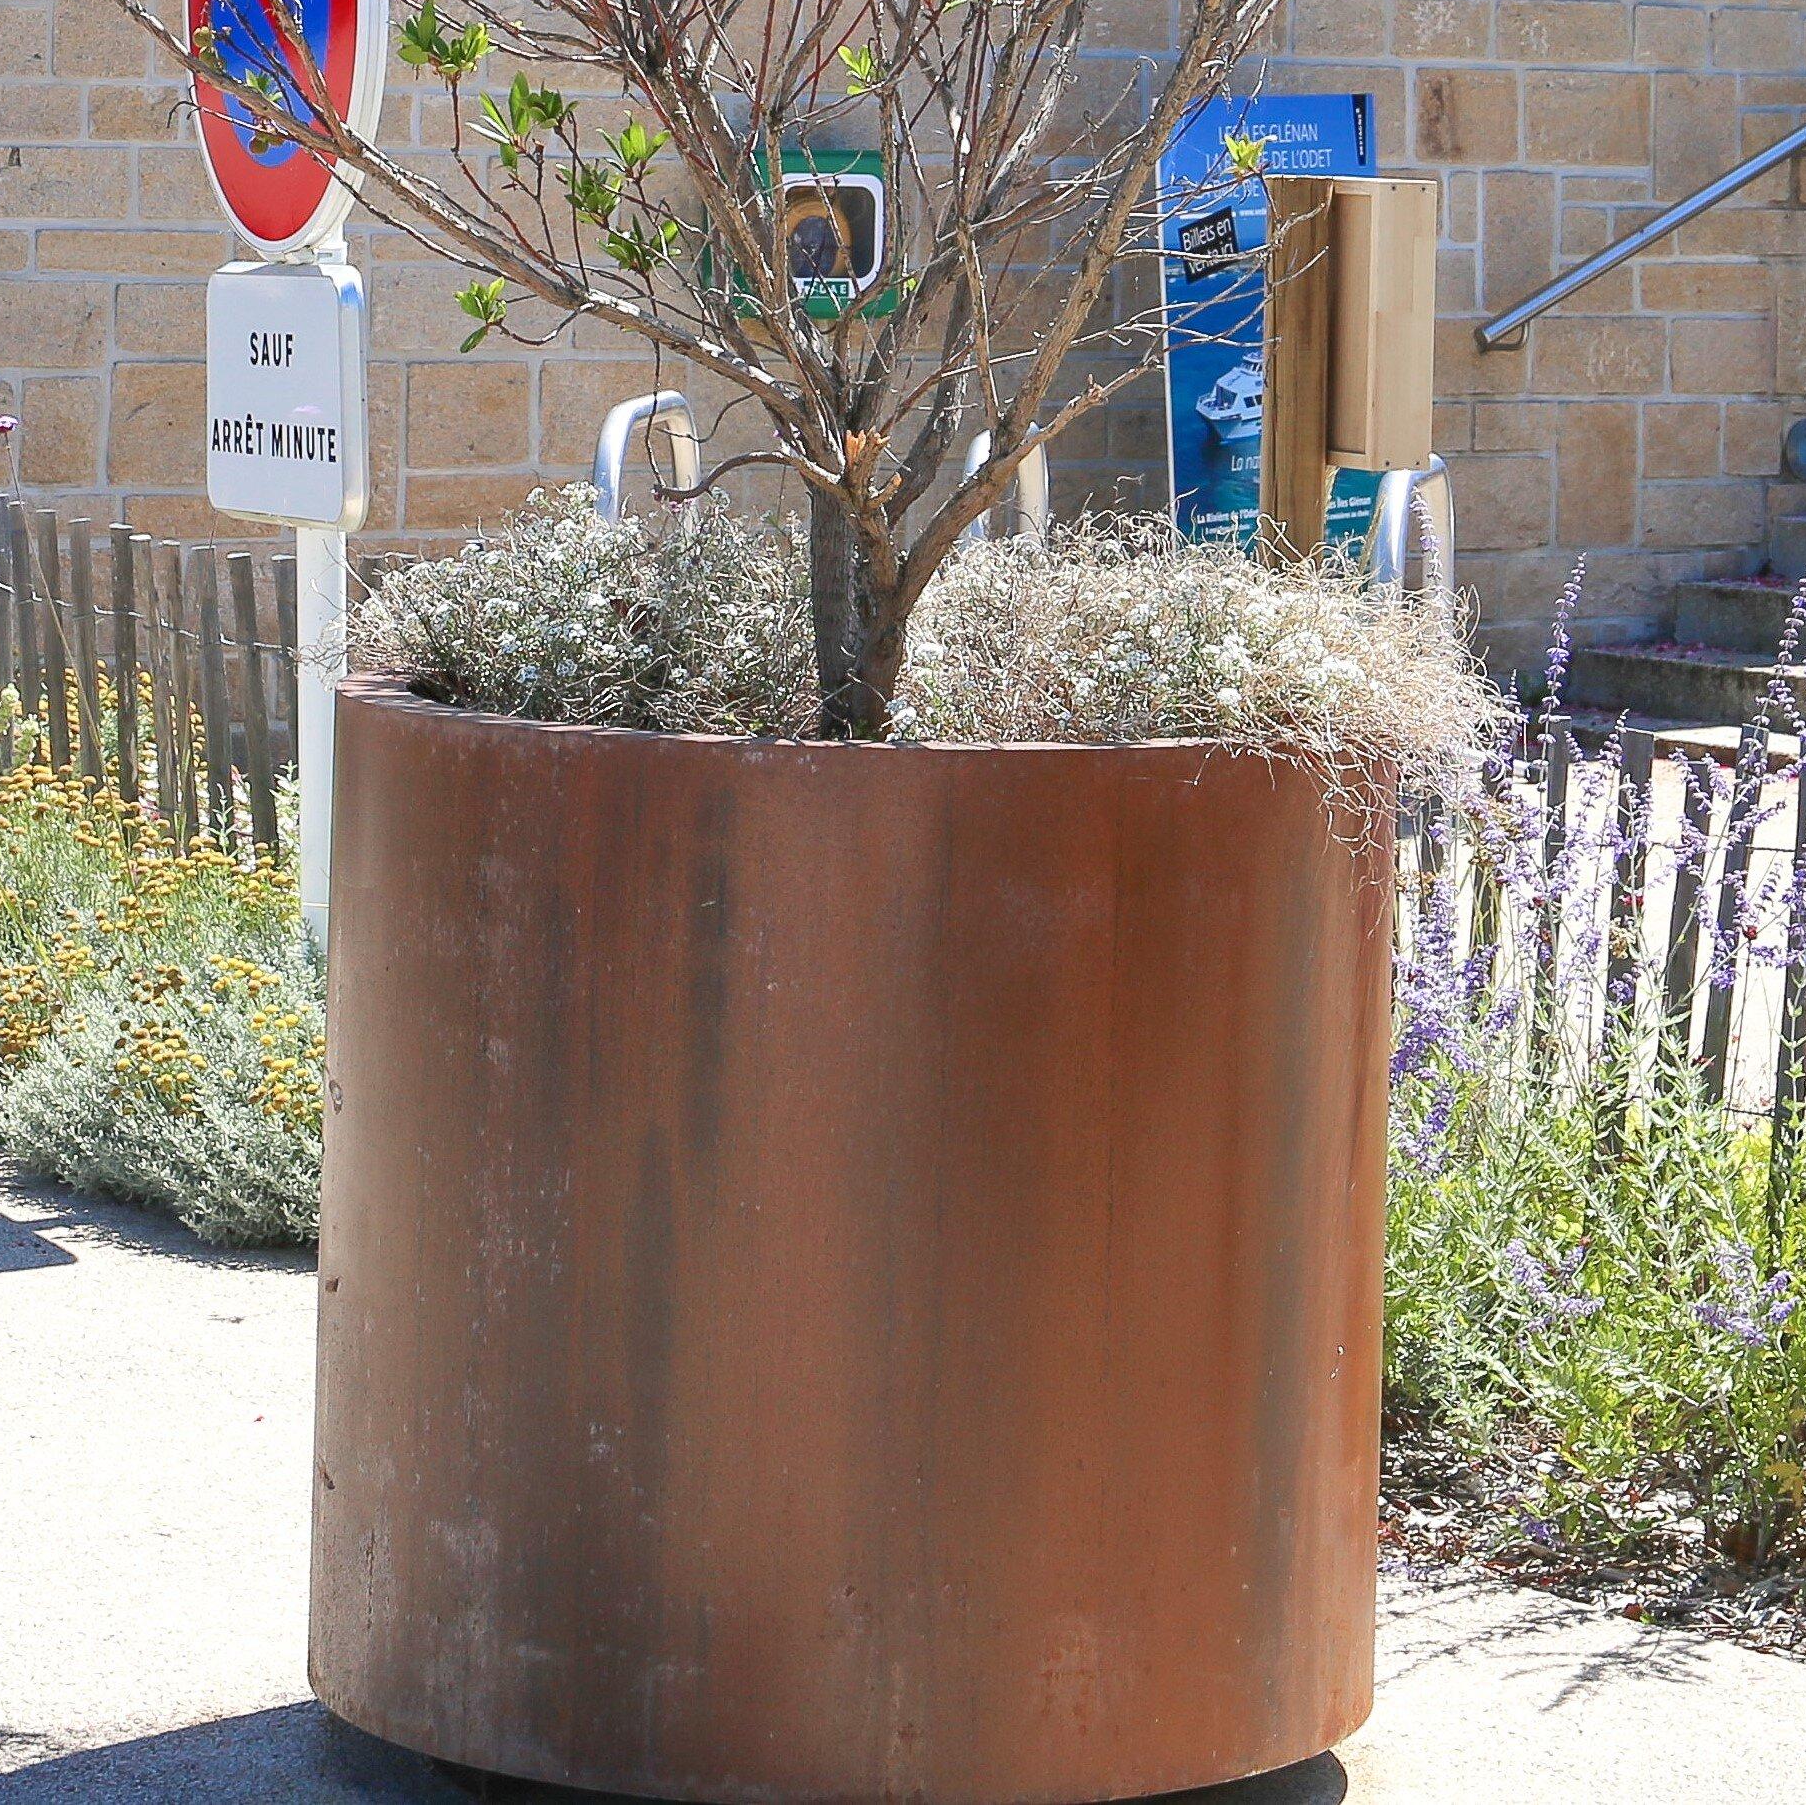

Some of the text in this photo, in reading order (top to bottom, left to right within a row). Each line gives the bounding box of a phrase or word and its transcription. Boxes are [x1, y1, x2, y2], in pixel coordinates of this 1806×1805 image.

[1272, 150, 1289, 169] DE
[1292, 148, 1332, 169] L'ODET
[1182, 218, 1231, 251] Billets en
[249, 332, 294, 367] SAUF
[211, 413, 337, 463] ARRÊT MINUTE
